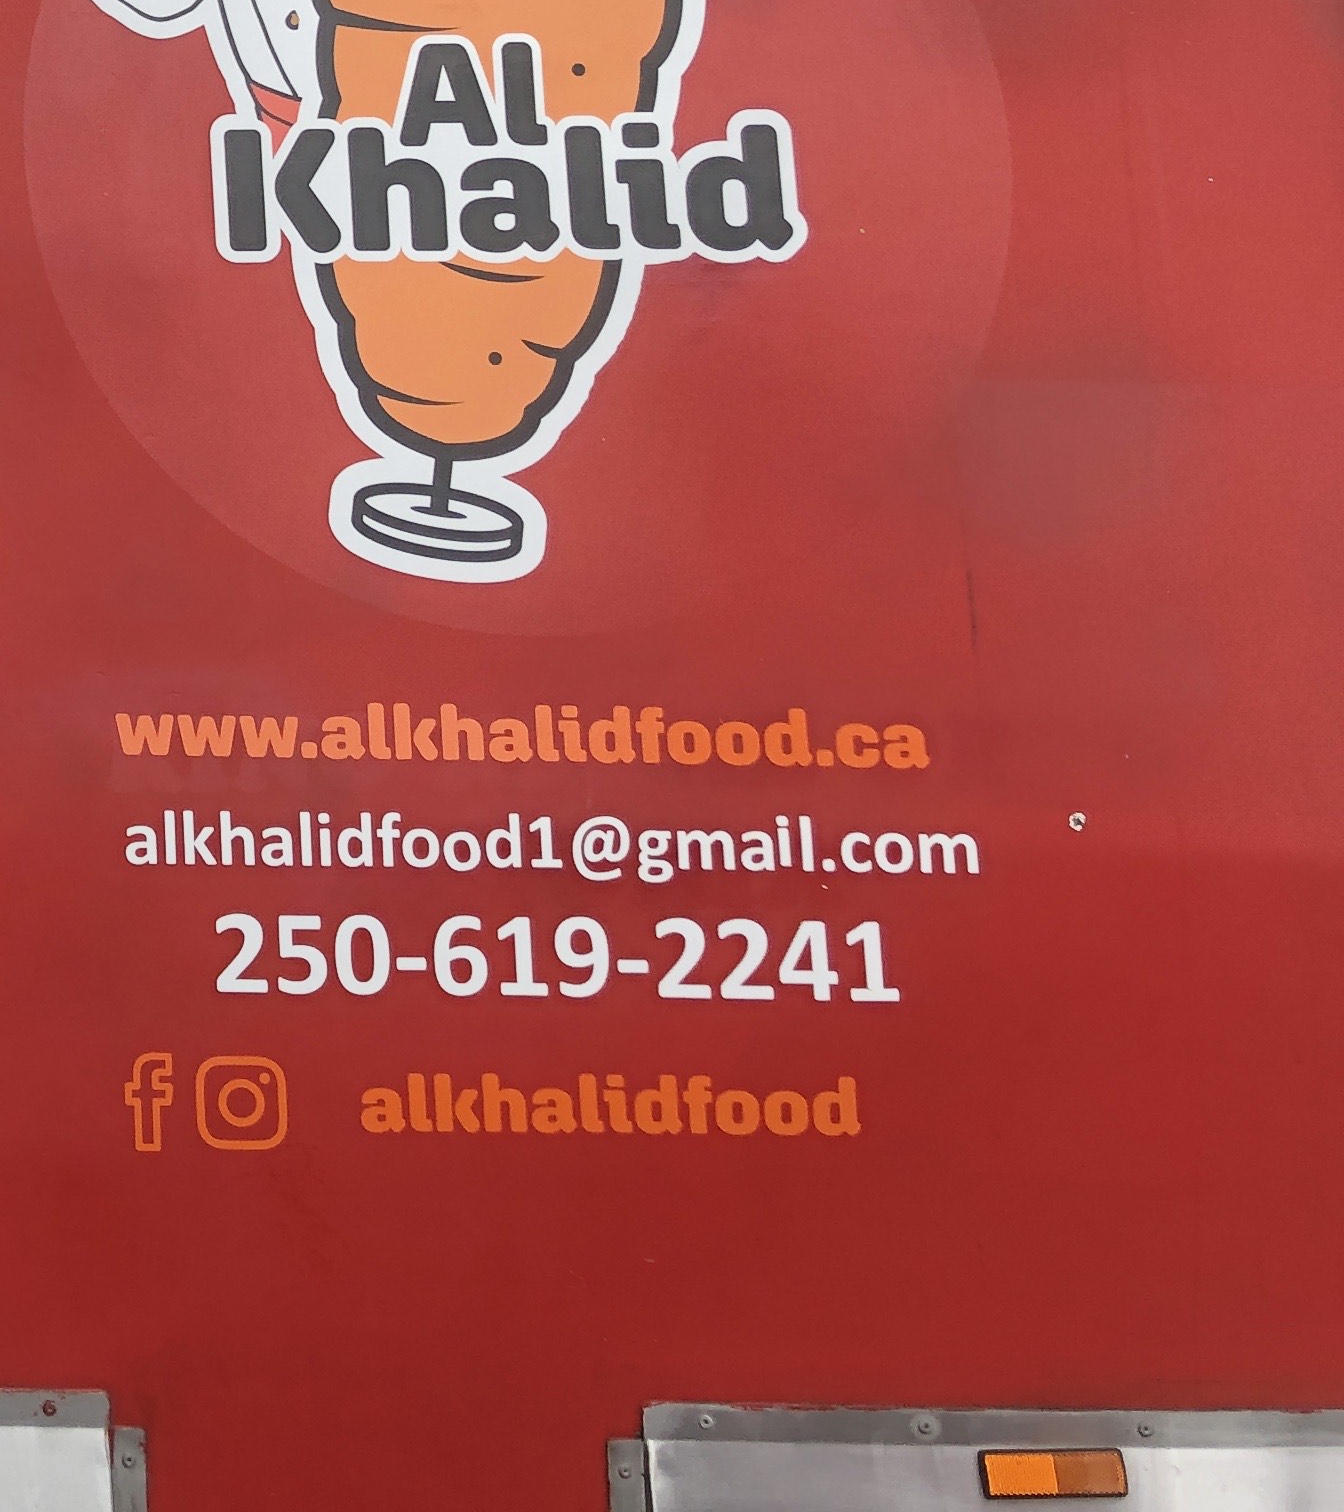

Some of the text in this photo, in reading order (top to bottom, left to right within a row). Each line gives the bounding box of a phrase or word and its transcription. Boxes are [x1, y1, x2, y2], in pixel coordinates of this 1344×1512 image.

[400, 41, 548, 147] Al
[223, 120, 797, 256] Khalid
[115, 702, 931, 770] www.alkhalidfood.ca
[124, 809, 981, 884] alkhalidfood1@gmail.com
[215, 913, 901, 1002] 250-619-2241
[360, 1072, 862, 1137] alkhalidfood
